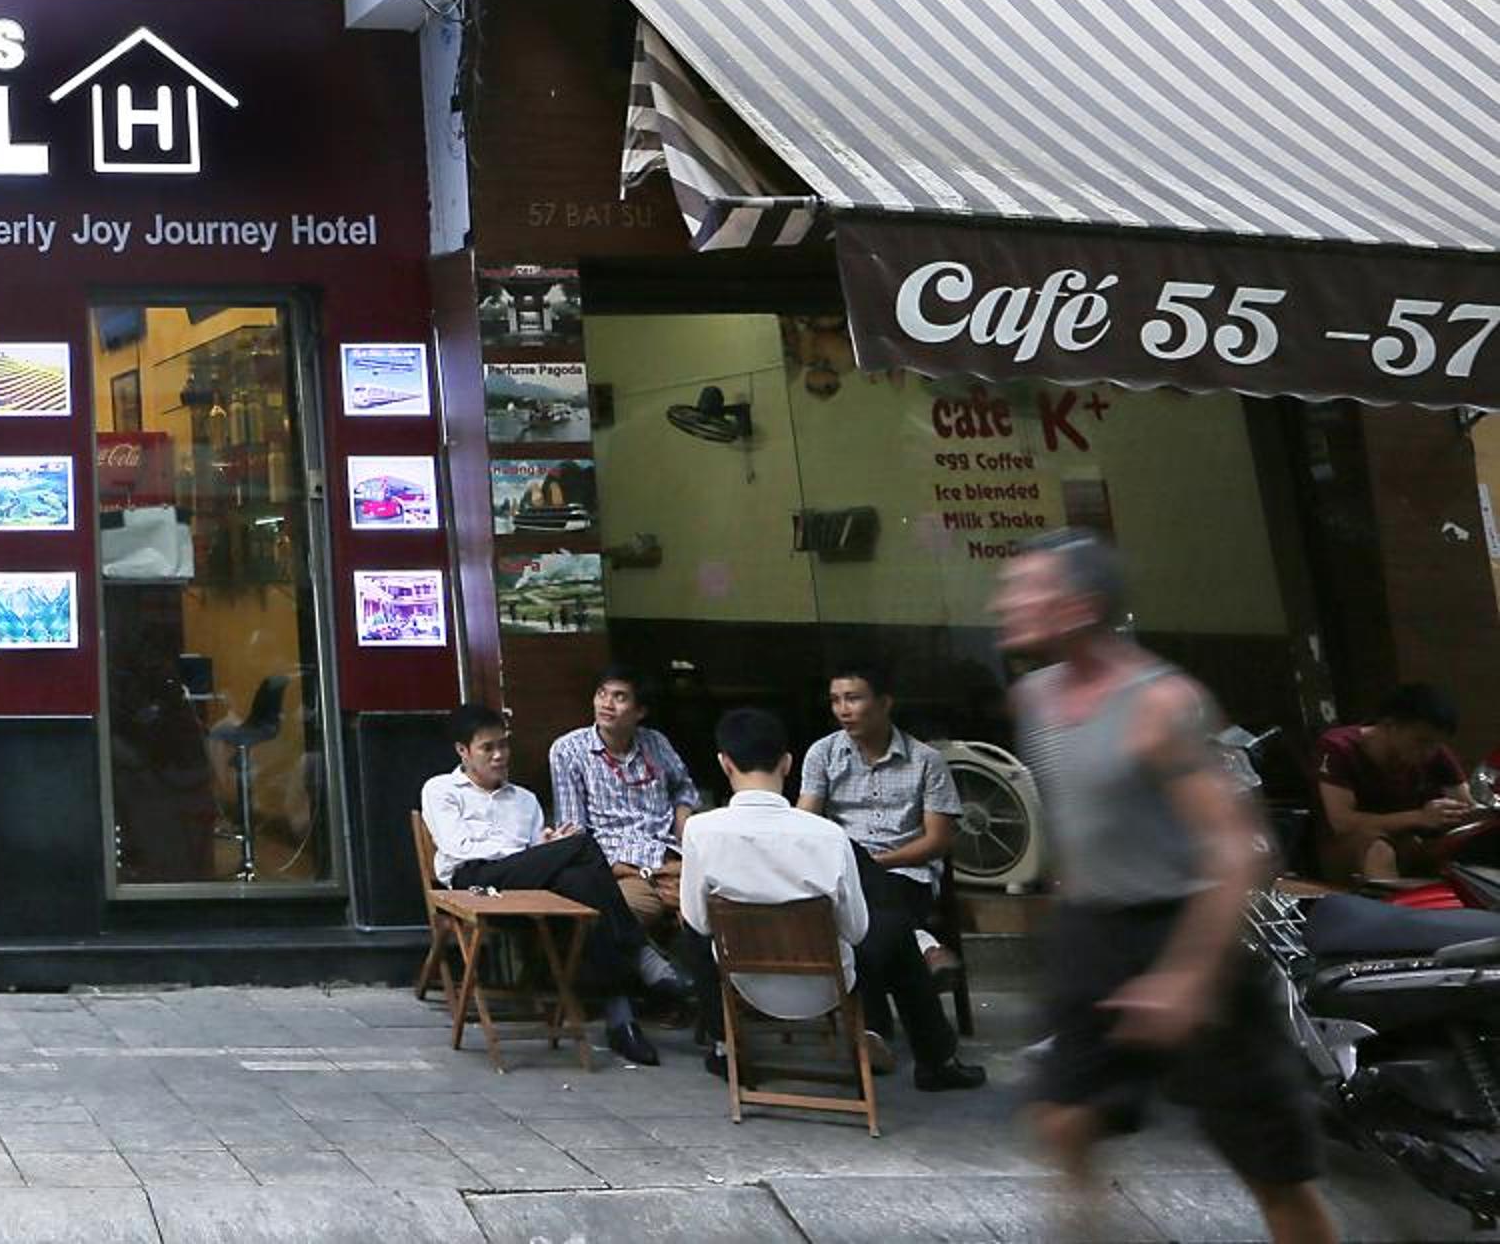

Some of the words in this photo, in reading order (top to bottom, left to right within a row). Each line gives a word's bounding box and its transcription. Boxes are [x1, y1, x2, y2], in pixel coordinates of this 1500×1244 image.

[71, 213, 131, 253] Joy
[145, 214, 277, 253] Journey
[291, 215, 377, 245] Hotel
[895, 261, 1119, 363] Café
[1140, 281, 1287, 365] 55
[487, 363, 536, 375] Perfume
[539, 364, 583, 376] Pagoda
[935, 484, 962, 501] Ice
[965, 483, 1040, 500] blended
[943, 511, 983, 530] Milk
[988, 510, 1046, 529] Shake
